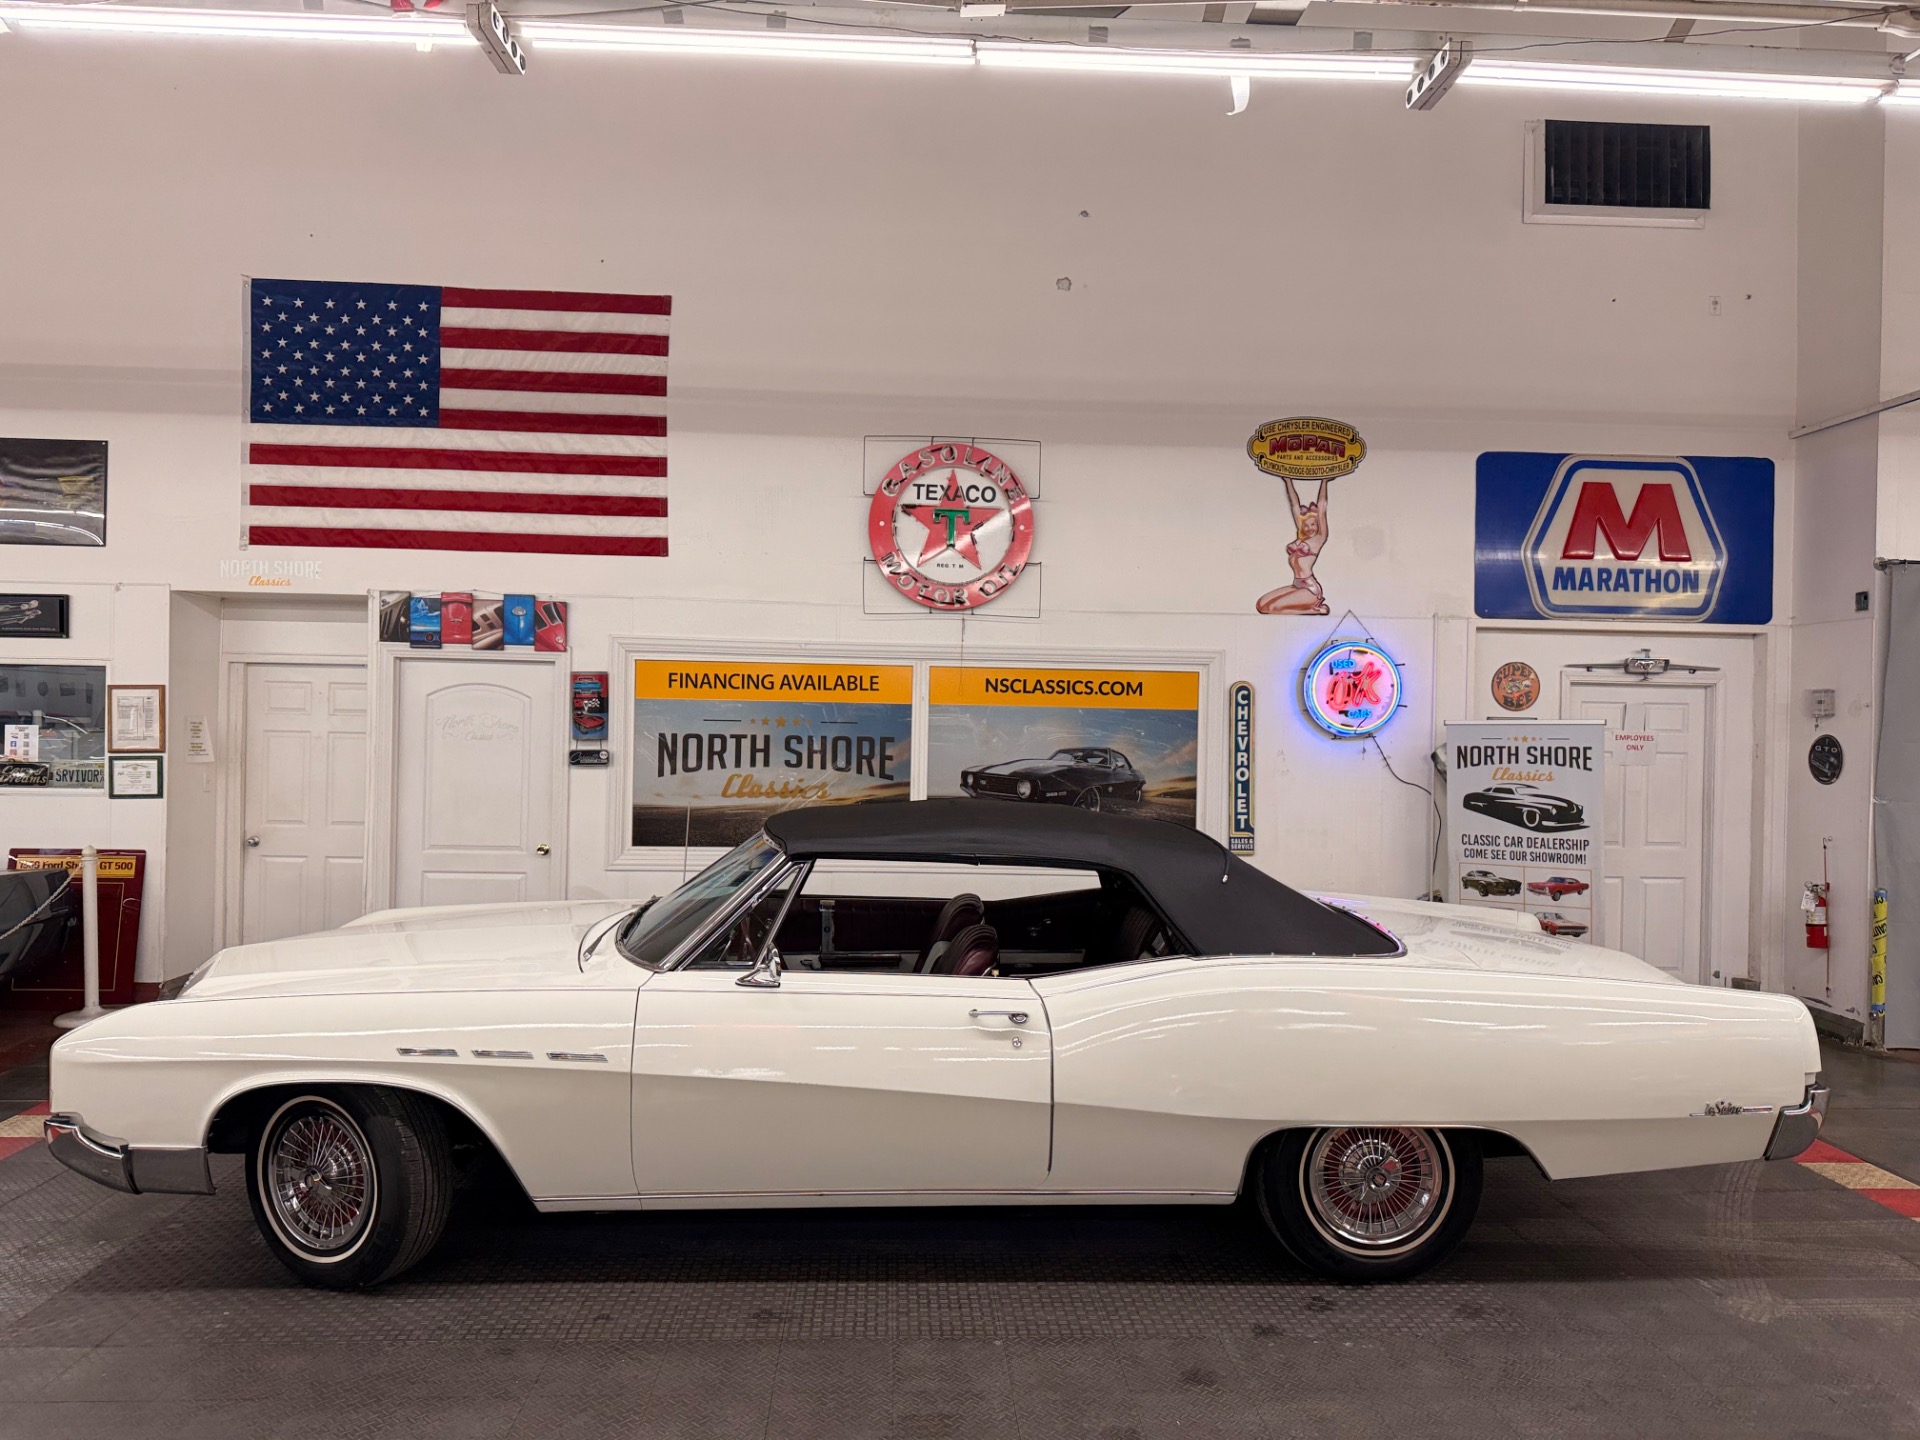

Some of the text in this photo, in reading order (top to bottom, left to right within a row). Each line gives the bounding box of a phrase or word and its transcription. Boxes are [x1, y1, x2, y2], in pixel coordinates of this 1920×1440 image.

[1264, 421, 1351, 436] USE CHRYSLER ENGINEERED
[1269, 434, 1346, 458] MOPAR
[881, 445, 1026, 504] GASOLINE
[912, 483, 997, 503] TEXACO
[1560, 481, 1692, 562] M
[220, 559, 322, 579] NORTH SHORE
[248, 575, 292, 587] Classics
[881, 552, 971, 608] MOTOR
[1552, 567, 1699, 593] MARATHON
[1331, 660, 1356, 669] USED
[668, 672, 880, 691] FINANCING AVAILABLE
[985, 677, 1143, 697] NSCLASSICS.COM
[1327, 662, 1382, 711] OK
[1615, 734, 1655, 742] EMPLOYEES
[657, 732, 895, 781] NORTH SHORE
[1236, 690, 1249, 829] CHEVROLET
[1457, 745, 1593, 772] NORTH SHORE
[56, 769, 98, 782] SRVIVOR
[1491, 767, 1555, 782] Classics
[721, 773, 833, 800] Classics
[1461, 833, 1590, 851] CLASSIC CAR DEALERSHIP
[99, 861, 133, 871] GT 500
[1463, 848, 1587, 865] COME SEE OUR SHOWROOM!
